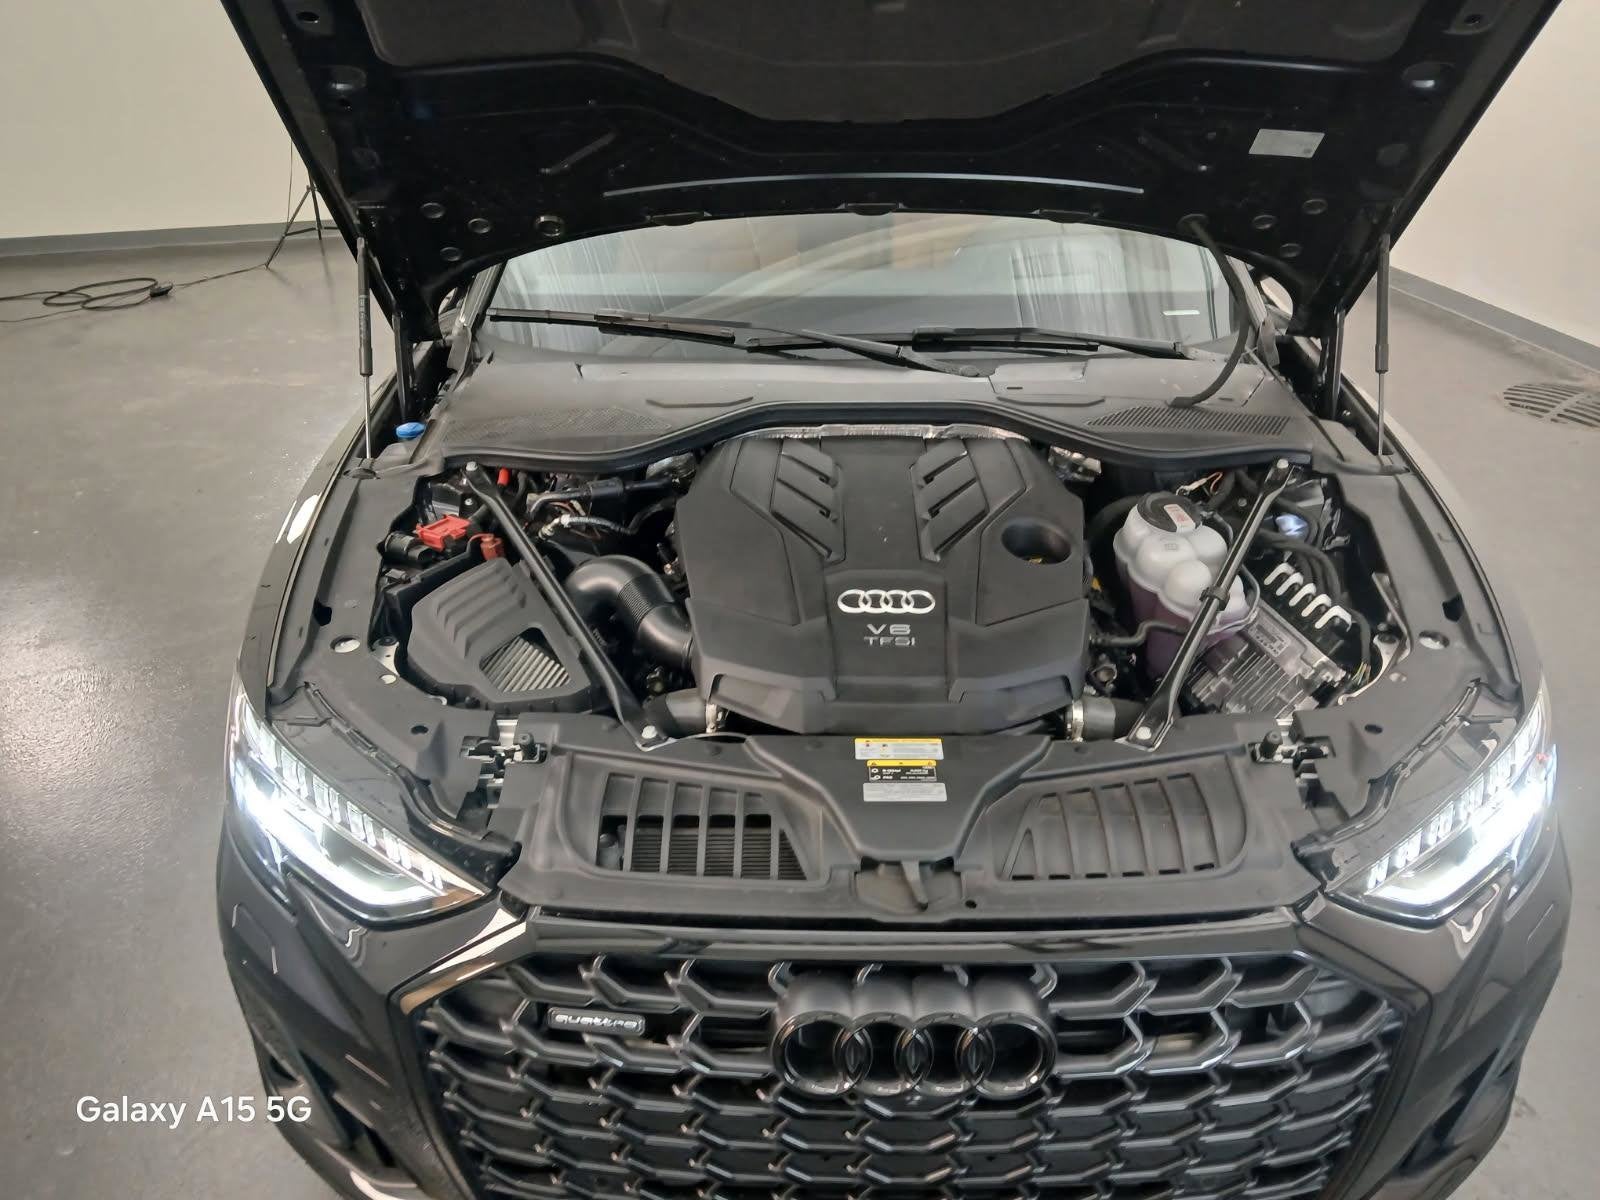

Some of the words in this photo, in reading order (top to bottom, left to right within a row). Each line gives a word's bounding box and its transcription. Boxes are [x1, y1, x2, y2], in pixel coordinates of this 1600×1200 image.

[867, 624, 911, 635] V6
[864, 636, 916, 646] TFSI
[555, 1014, 638, 1029] quattro
